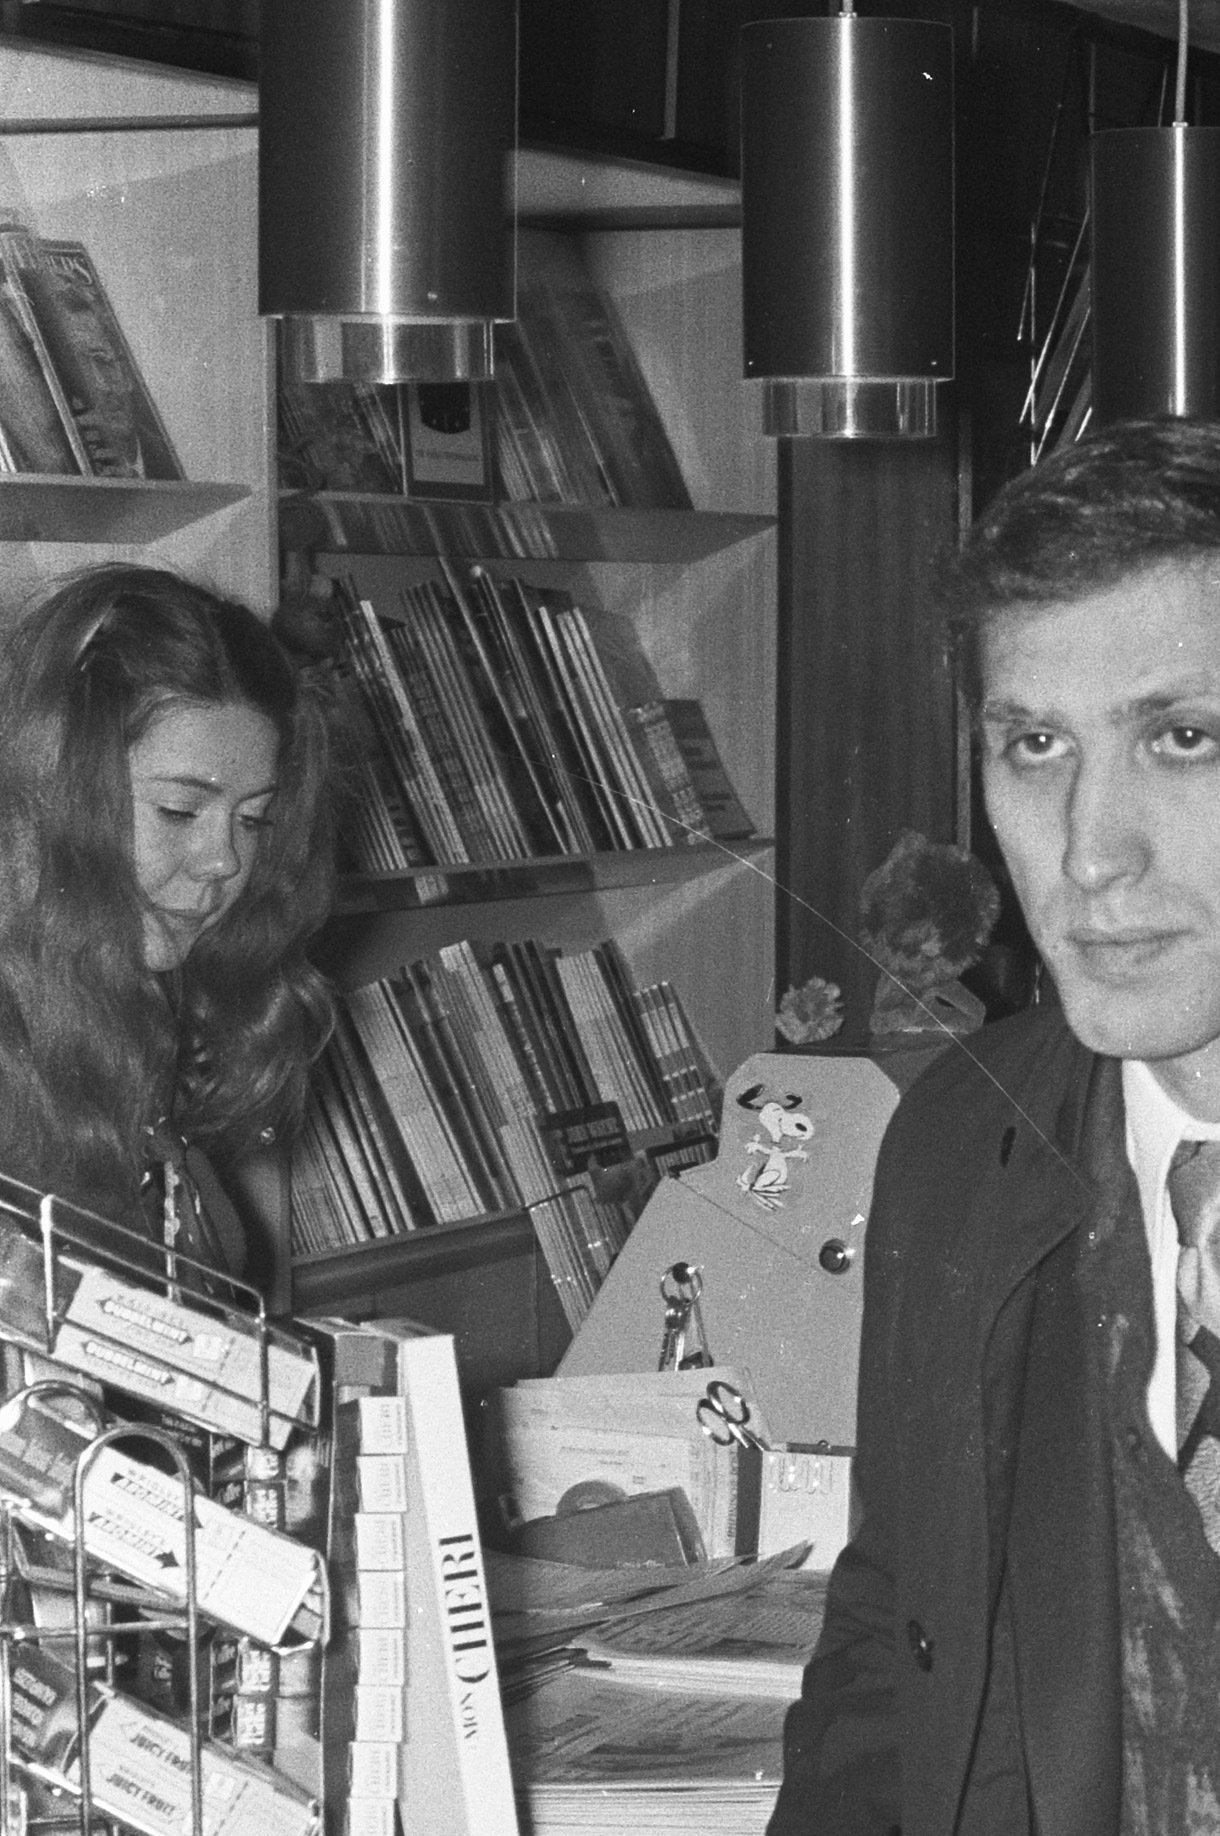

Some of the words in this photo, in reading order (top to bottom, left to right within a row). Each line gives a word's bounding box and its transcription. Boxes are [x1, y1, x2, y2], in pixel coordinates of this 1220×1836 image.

[439, 1533, 491, 1685] CHERI
[458, 1691, 479, 1741] MON
[129, 1733, 164, 1759] JUICY
[105, 1773, 141, 1799] JUICY
[139, 1790, 176, 1817] FRUIT
